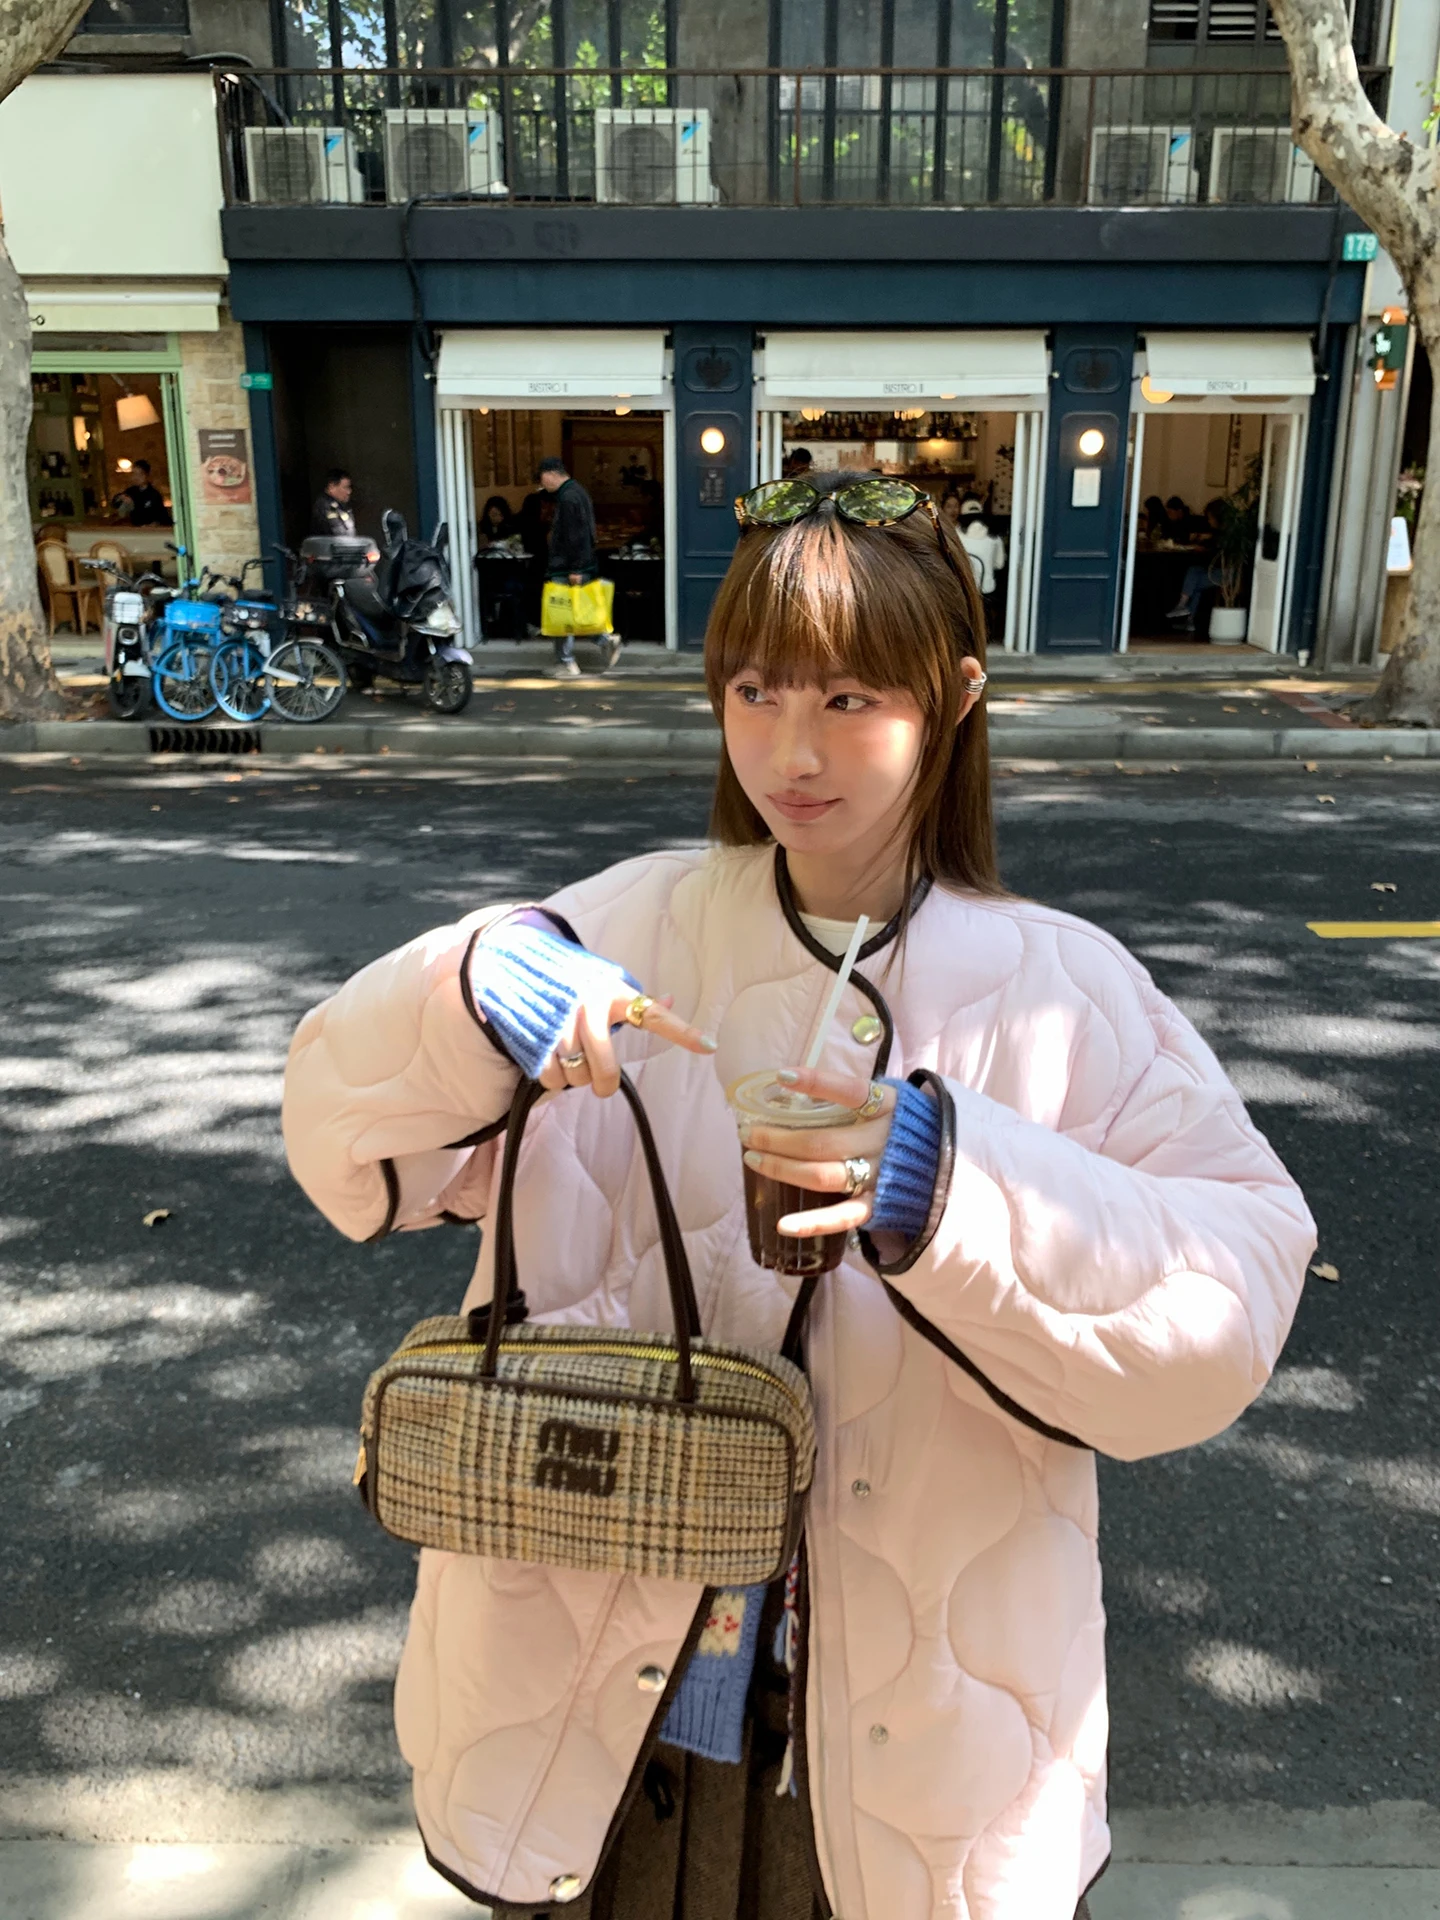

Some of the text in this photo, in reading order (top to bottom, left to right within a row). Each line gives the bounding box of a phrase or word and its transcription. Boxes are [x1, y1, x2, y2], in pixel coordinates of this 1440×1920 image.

[1347, 234, 1377, 253] 179
[528, 382, 560, 393] BISTRO
[883, 383, 916, 394] BISTRO
[1207, 381, 1240, 391] BISTRO
